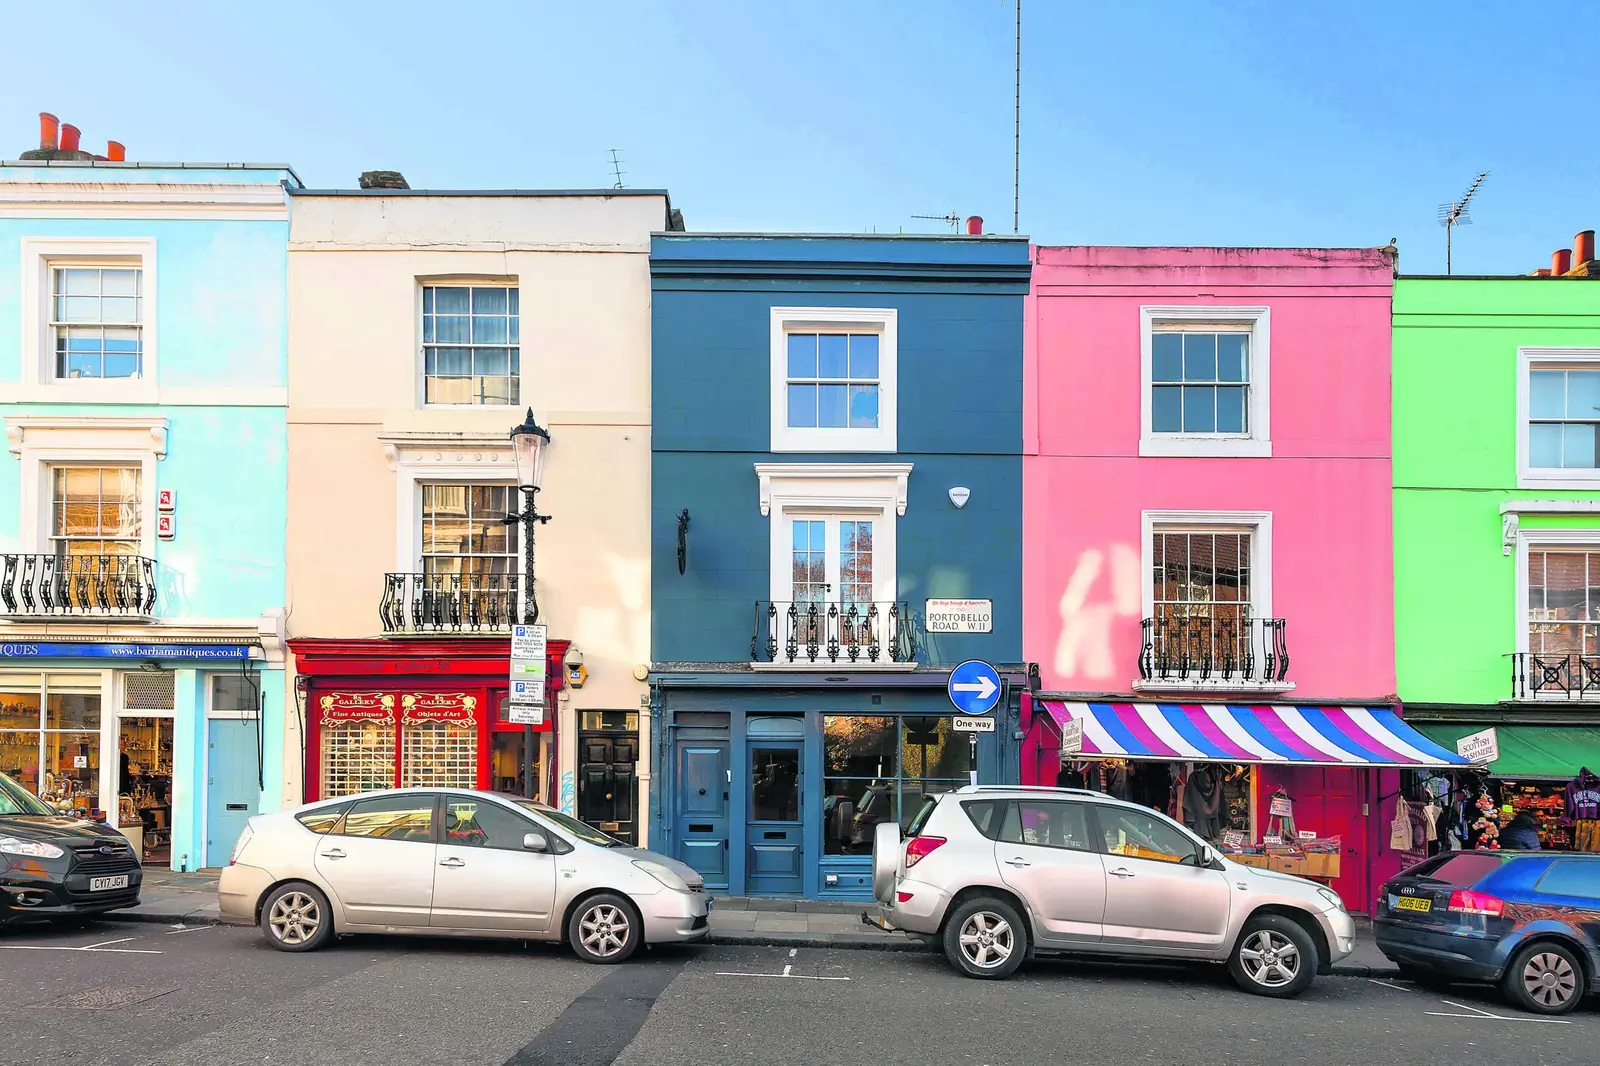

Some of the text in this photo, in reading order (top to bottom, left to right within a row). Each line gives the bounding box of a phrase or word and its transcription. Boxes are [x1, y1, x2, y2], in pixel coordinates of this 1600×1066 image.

[930, 613, 990, 622] PORTOBELLO
[111, 646, 243, 658] www.barhamantiques.co.uk
[956, 719, 991, 729] One way
[1462, 737, 1490, 752] SCOTTISH
[1414, 899, 1429, 911] UEB
